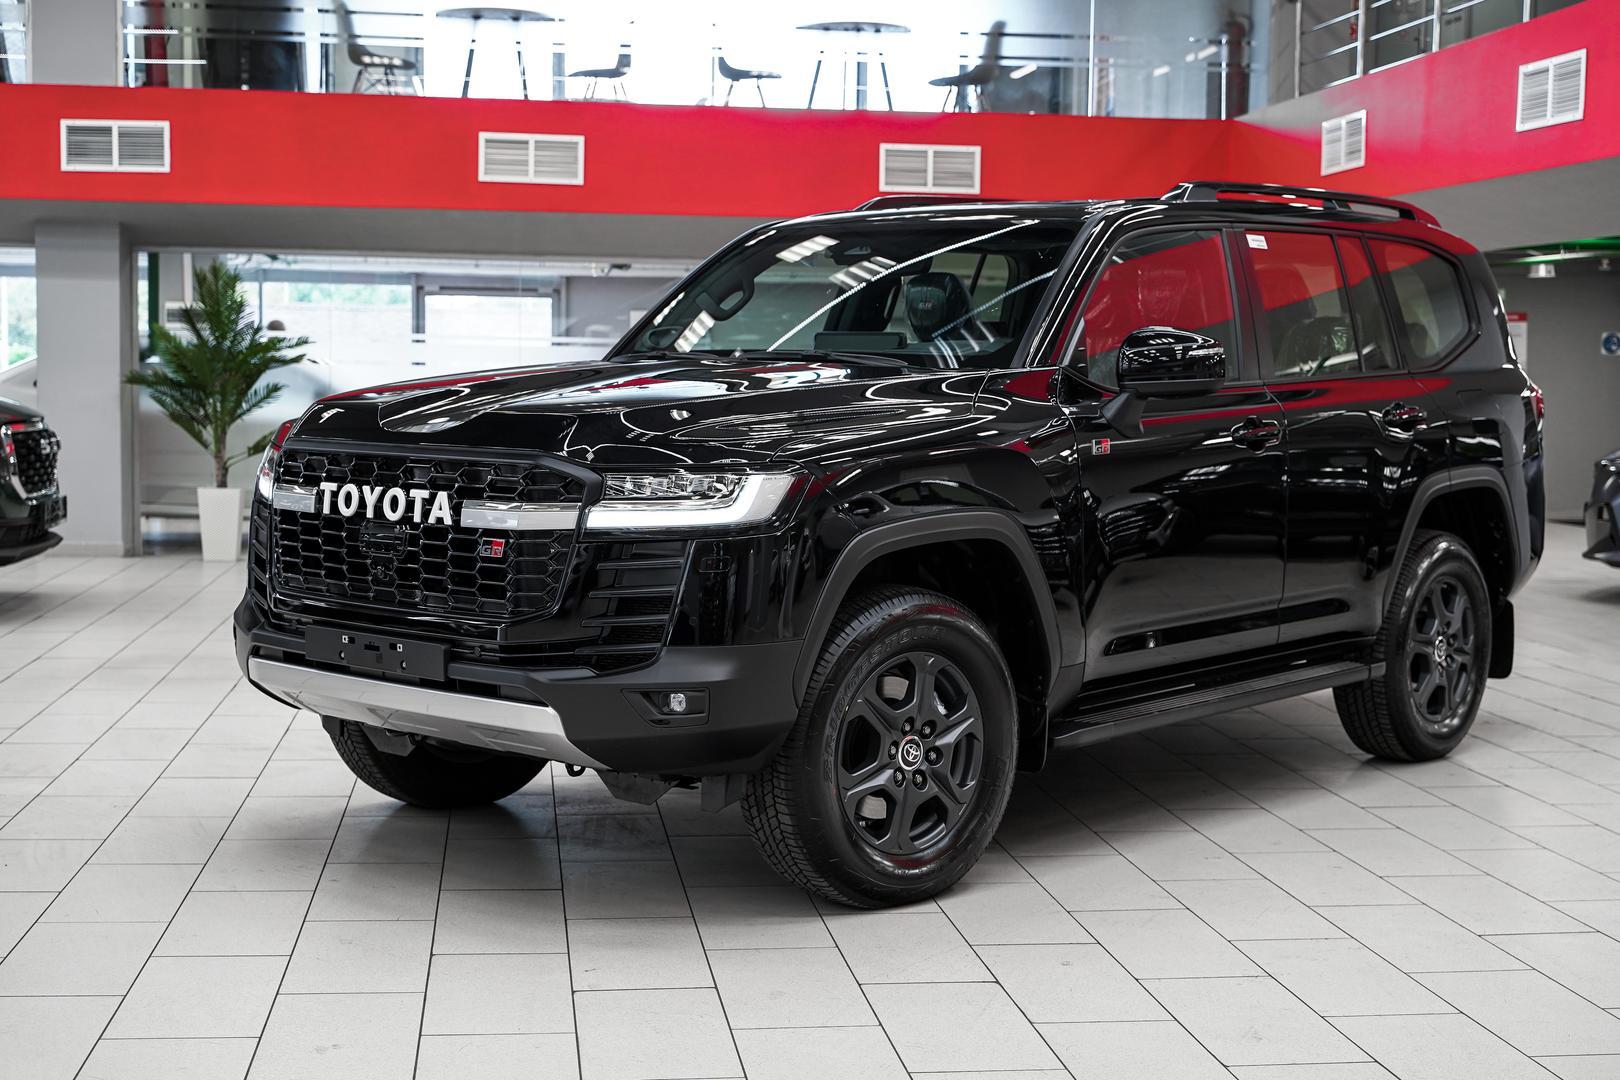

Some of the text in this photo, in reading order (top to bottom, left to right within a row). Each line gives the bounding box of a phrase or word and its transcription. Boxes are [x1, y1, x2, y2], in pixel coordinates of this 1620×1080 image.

[1094, 443, 1111, 454] GR
[320, 482, 453, 526] TOYOTA
[481, 544, 502, 556] GR
